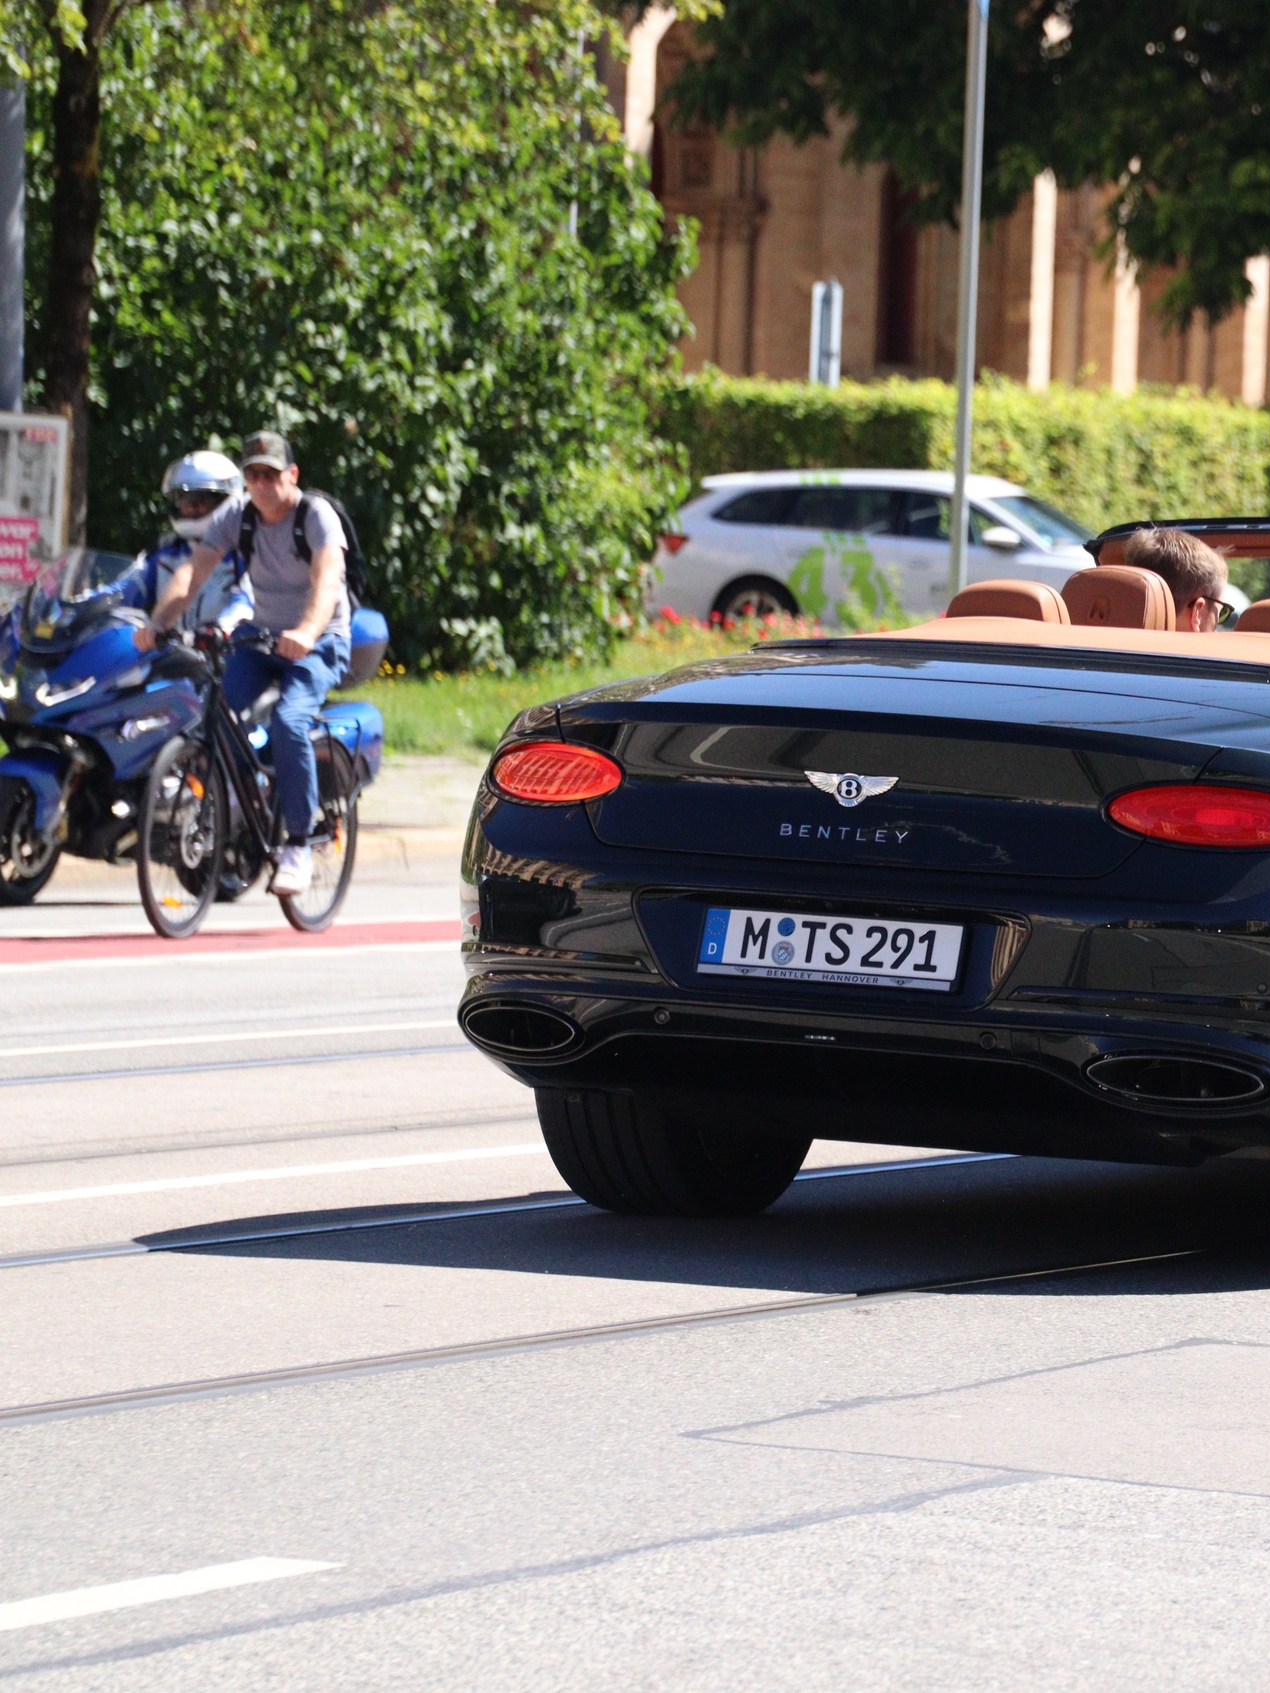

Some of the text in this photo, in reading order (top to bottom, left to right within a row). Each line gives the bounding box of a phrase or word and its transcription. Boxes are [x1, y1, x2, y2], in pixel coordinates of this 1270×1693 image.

[779, 823, 909, 844] BENTLEY
[707, 916, 937, 973] D M TS 291
[766, 969, 879, 985] BENTLEY HANNOVER
